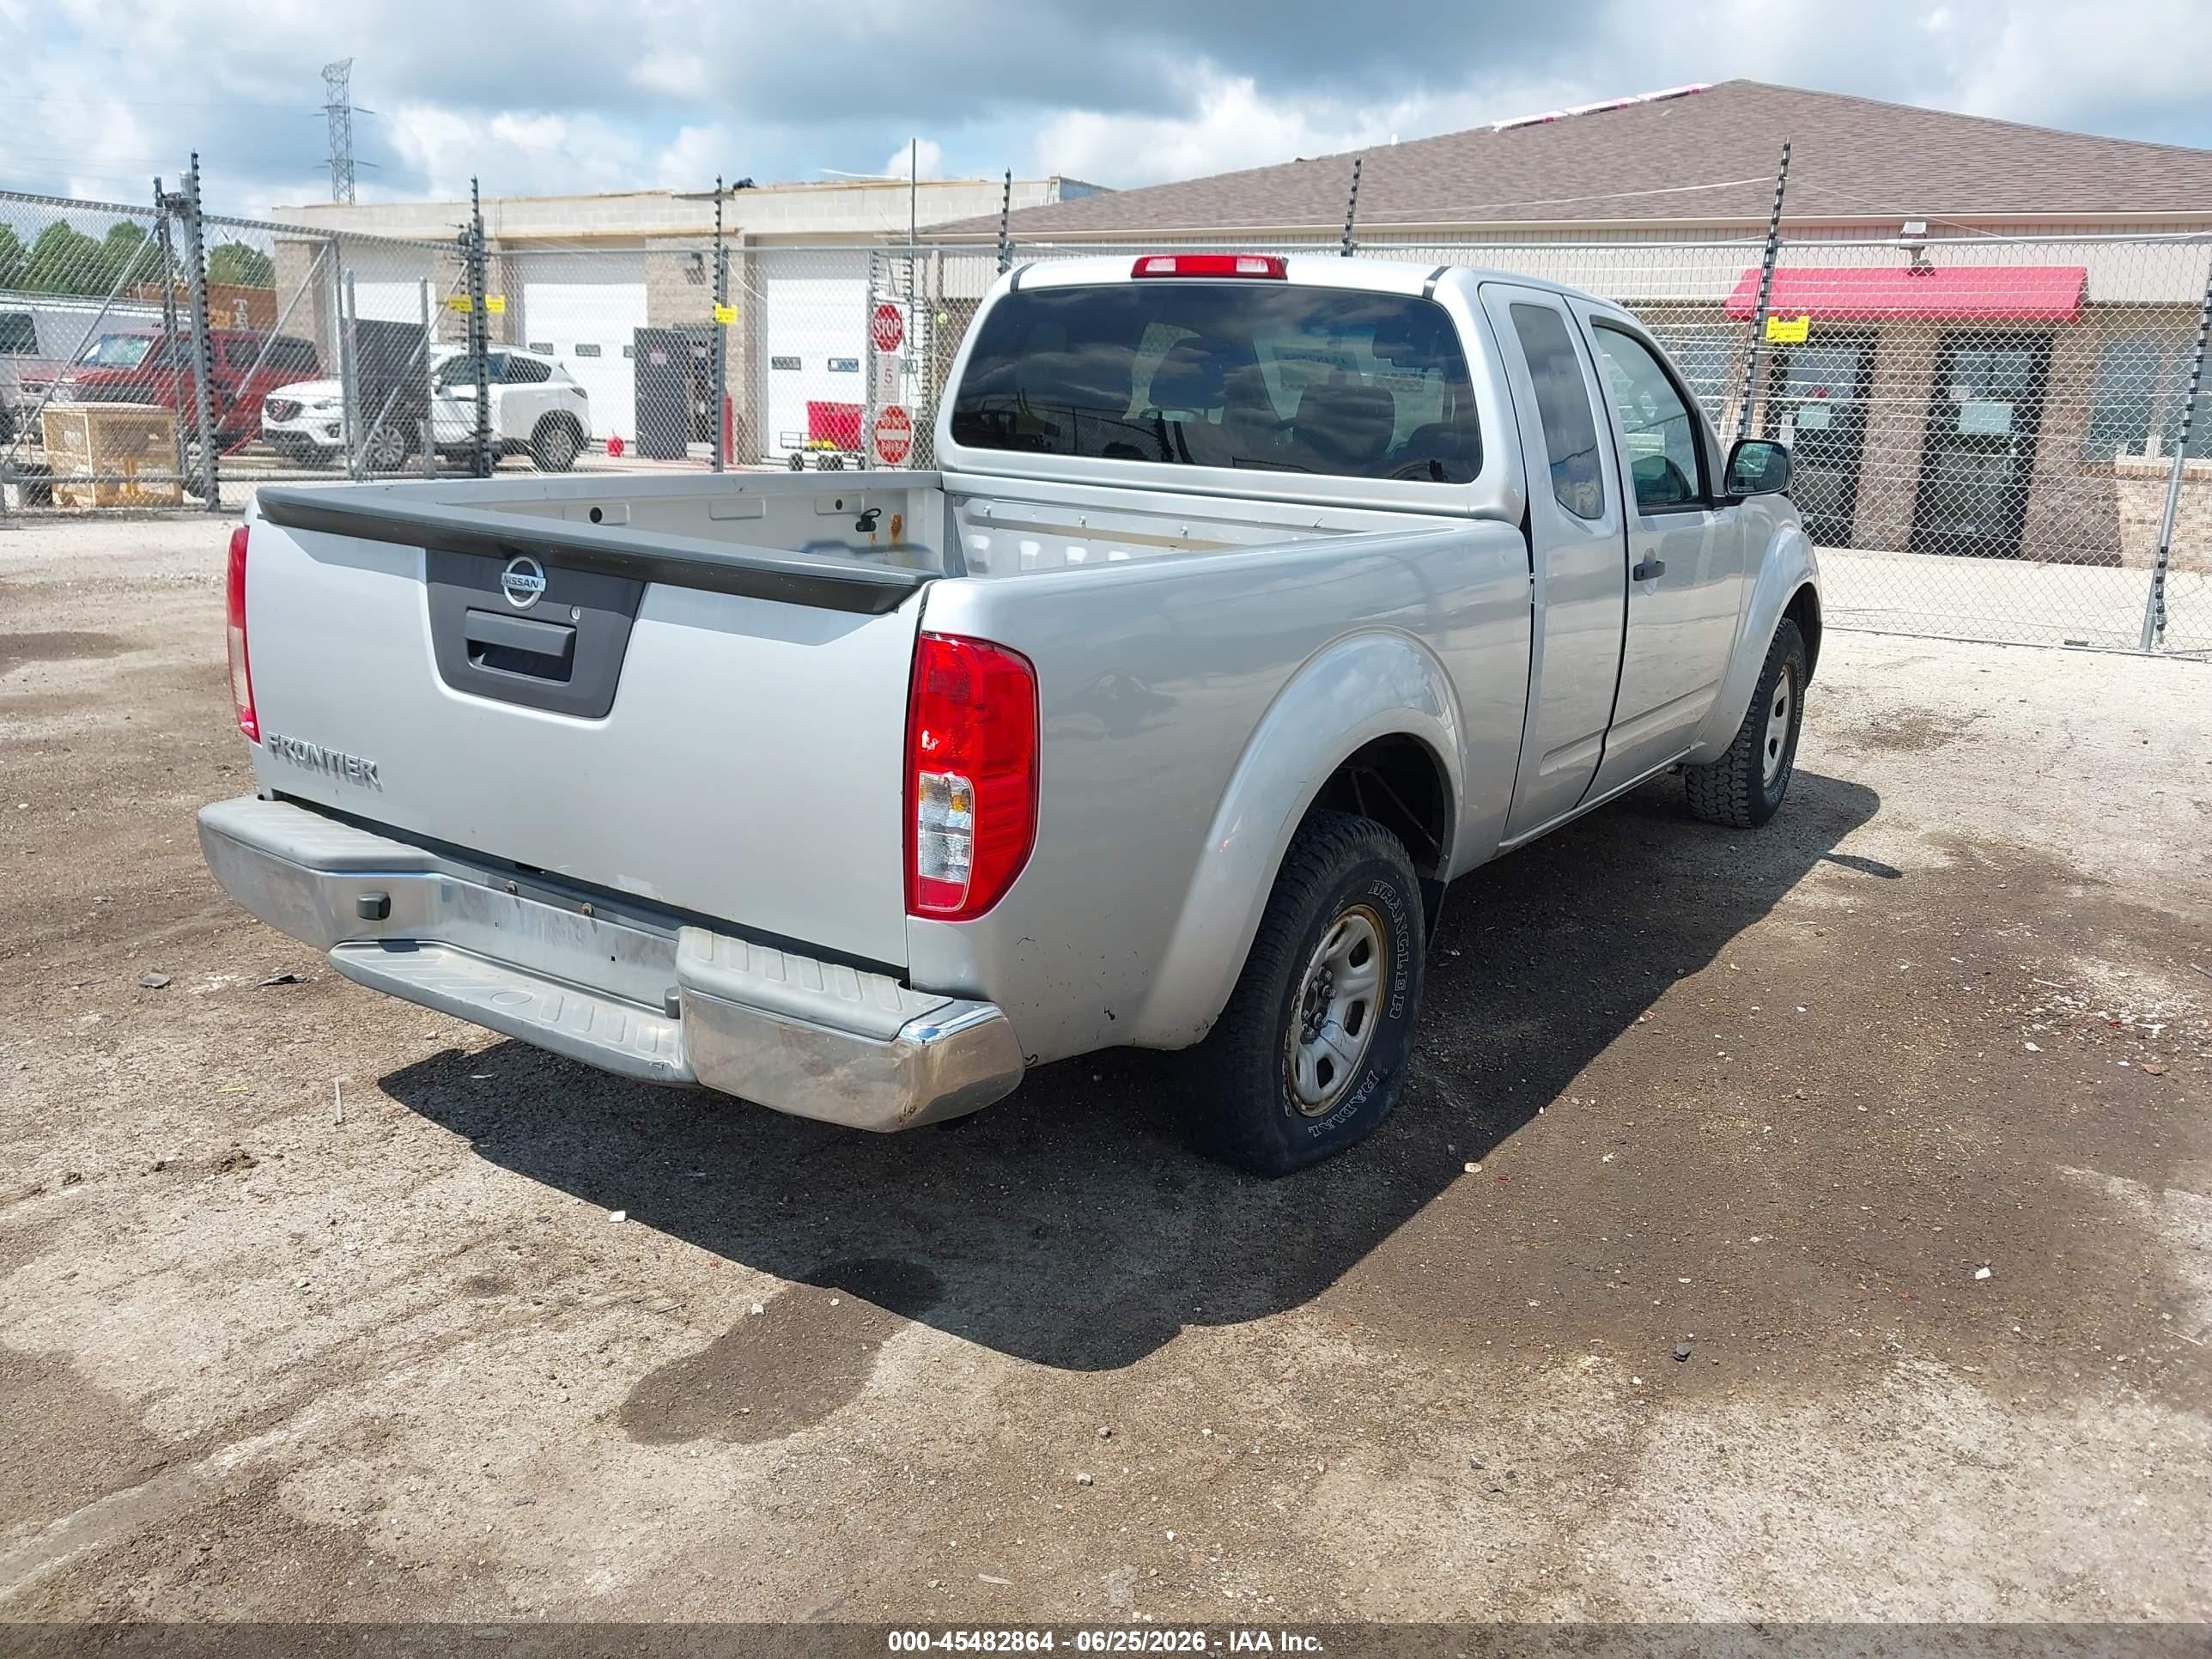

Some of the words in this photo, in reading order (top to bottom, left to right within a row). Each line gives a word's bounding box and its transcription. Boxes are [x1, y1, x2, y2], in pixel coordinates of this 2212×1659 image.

[874, 318, 902, 337] STOP
[884, 368, 893, 385] 5
[504, 575, 539, 588] NISSAN
[266, 731, 382, 787] FRONTIER
[1368, 879, 1409, 1020] WRANGLER
[1307, 1070, 1380, 1138] RADIAL
